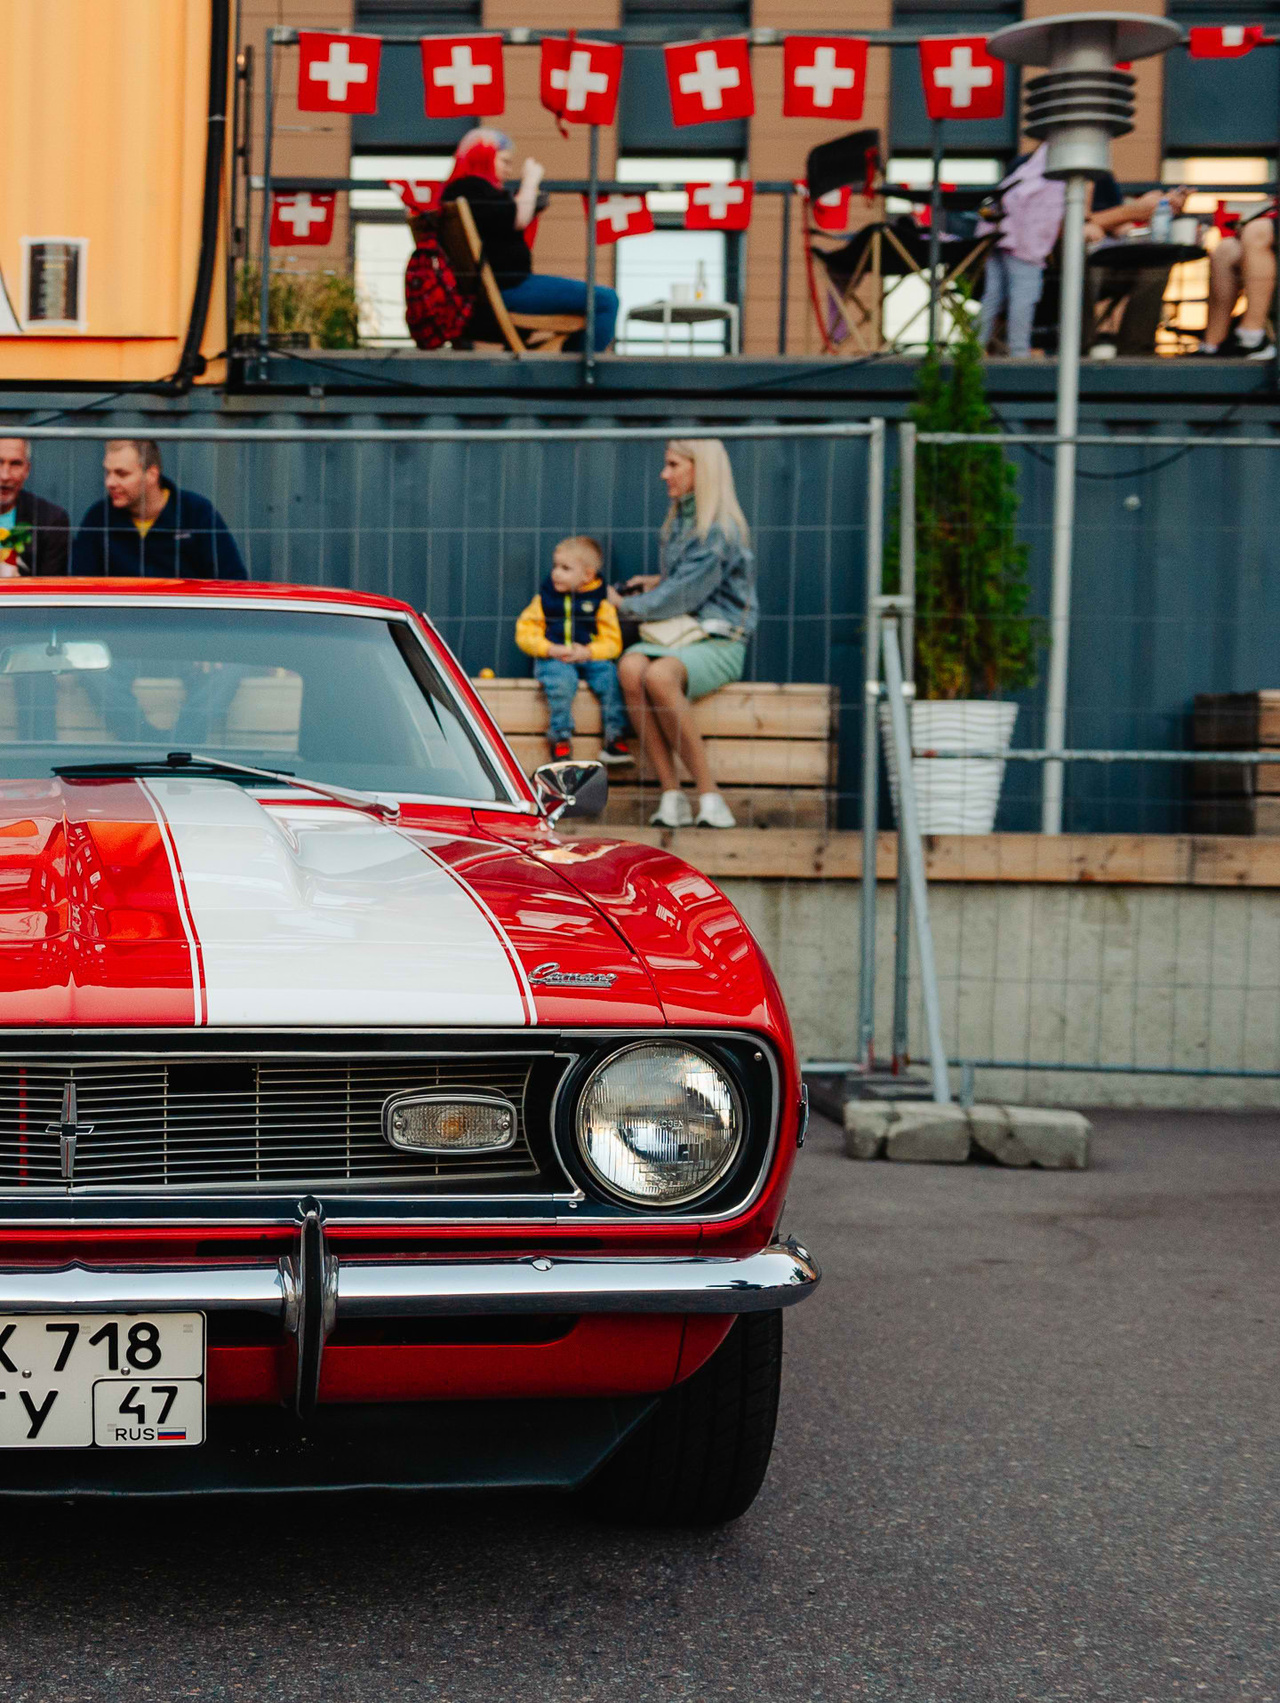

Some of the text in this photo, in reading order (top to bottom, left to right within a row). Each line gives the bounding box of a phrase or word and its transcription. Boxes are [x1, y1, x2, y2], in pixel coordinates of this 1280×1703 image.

[528, 962, 618, 986] Camaro
[45, 1321, 162, 1372] 718
[118, 1385, 179, 1425] 47
[114, 1427, 156, 1442] RUS
